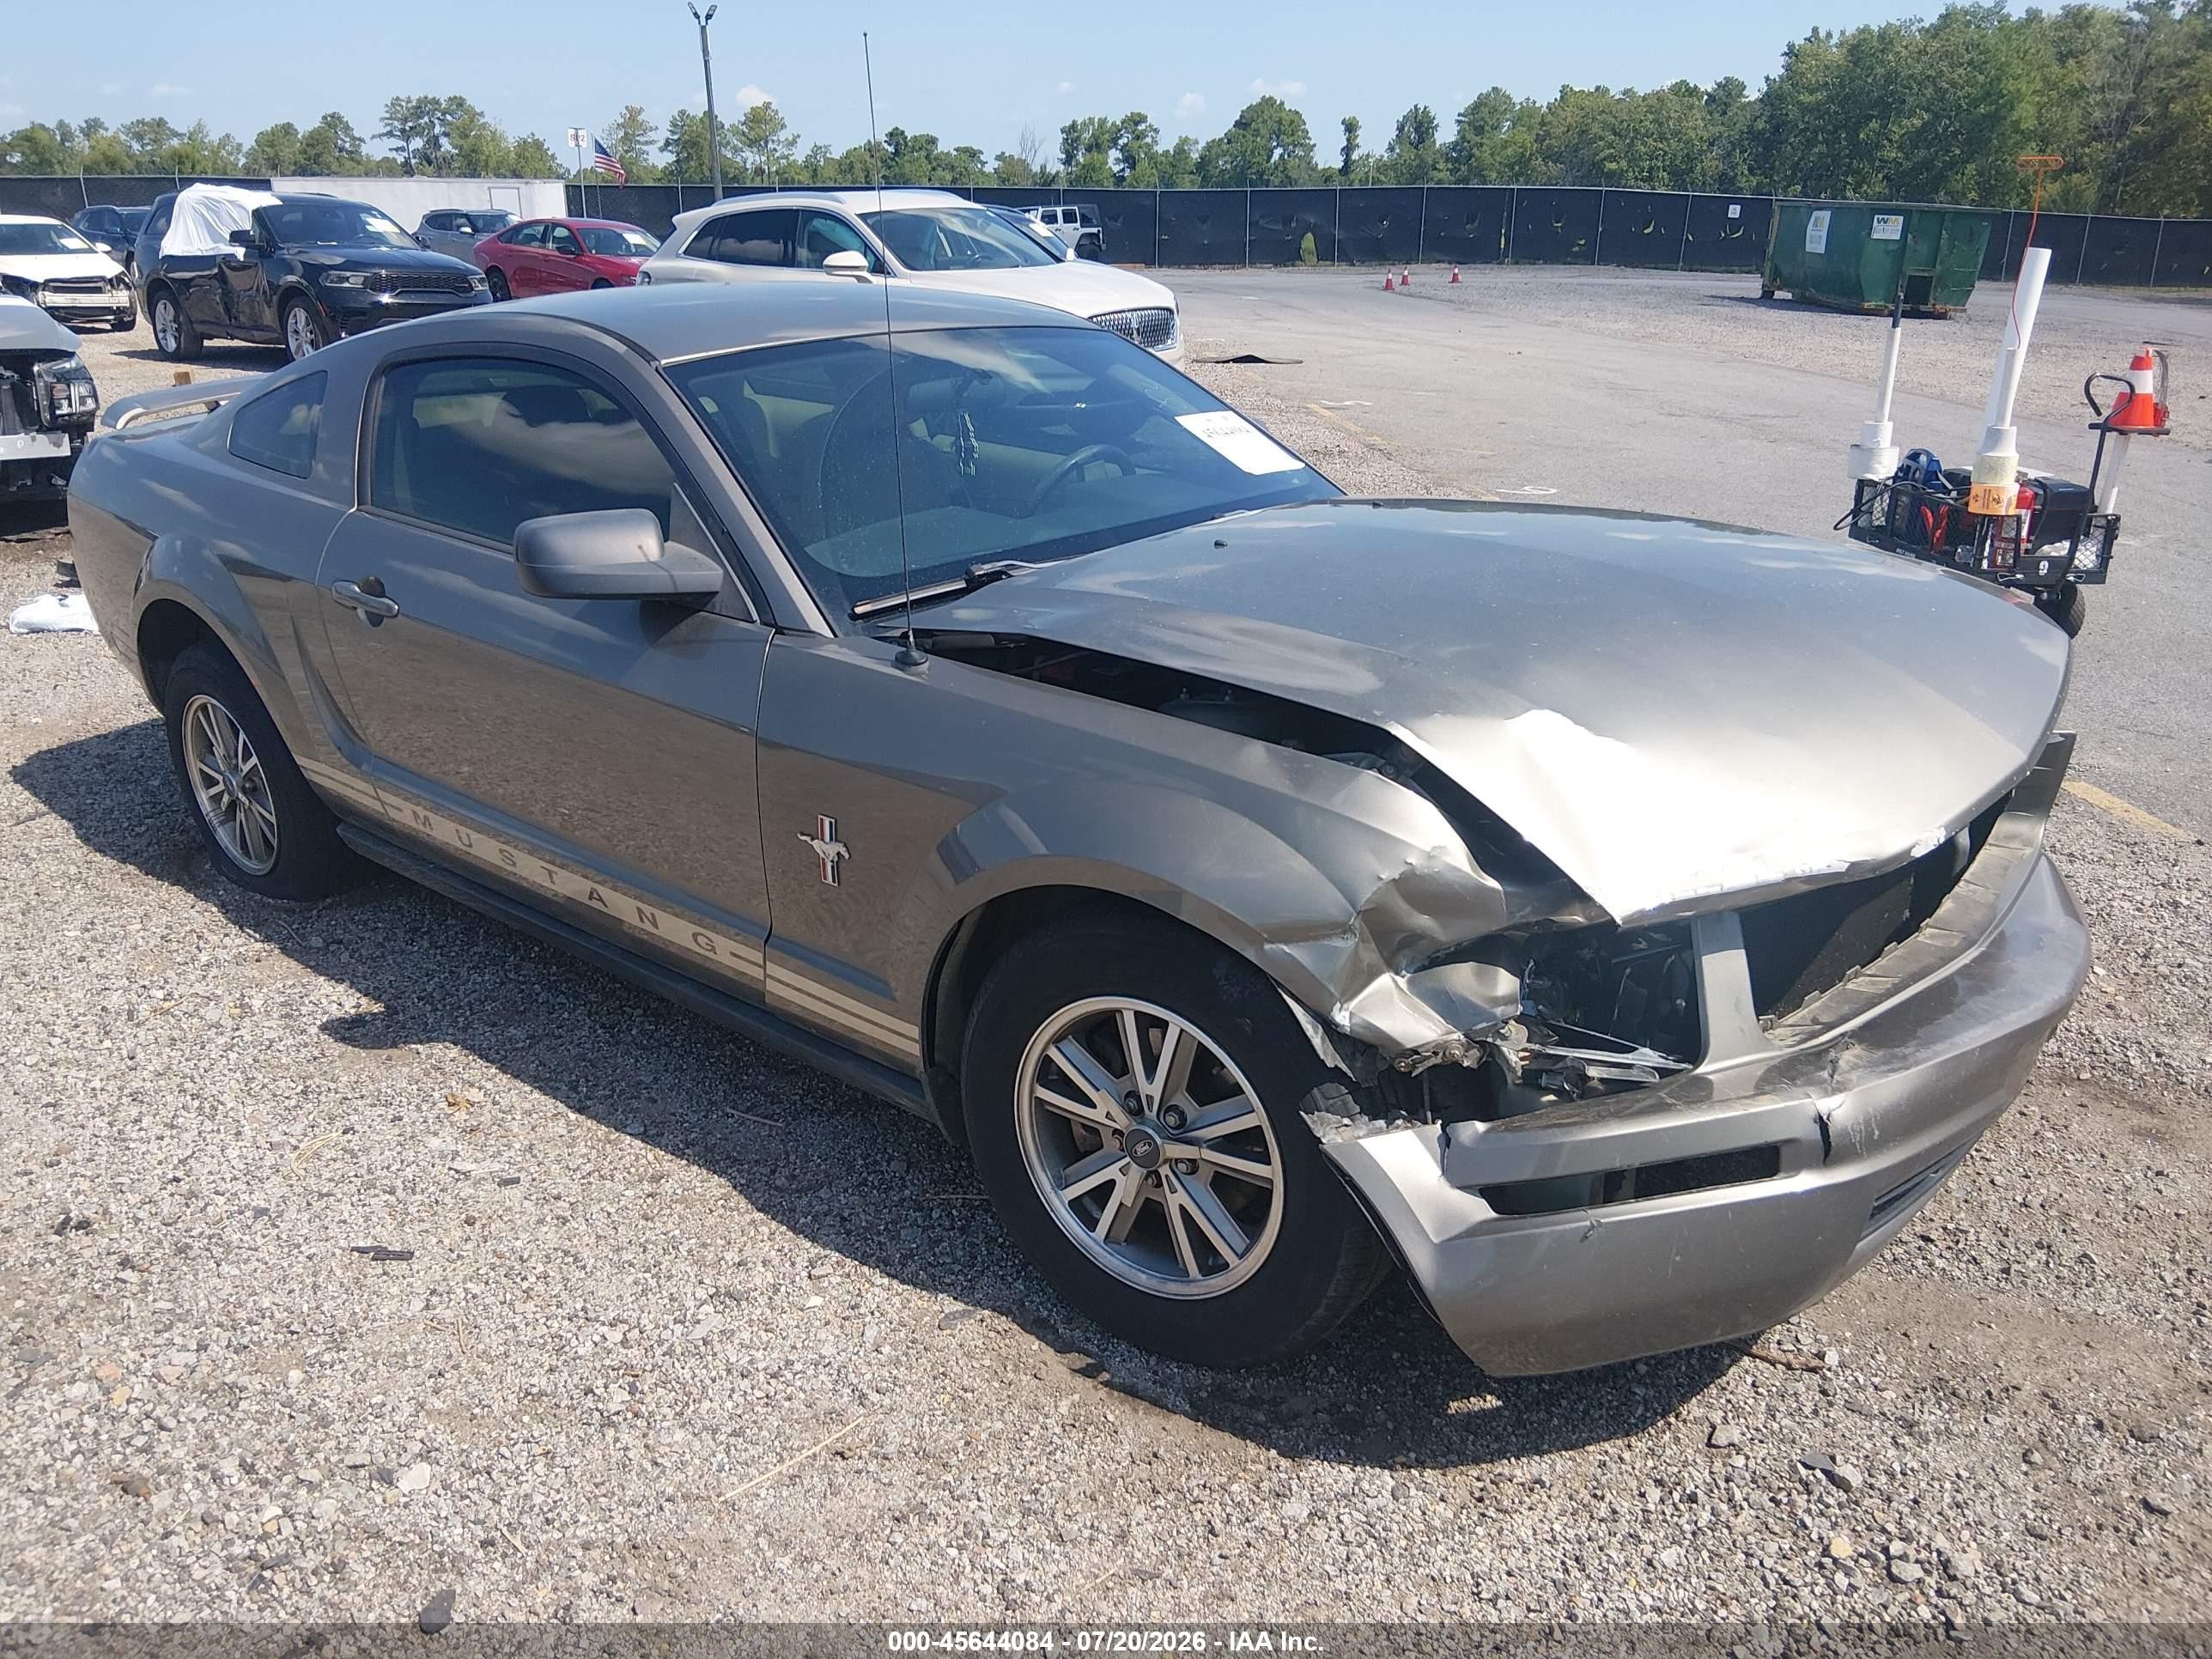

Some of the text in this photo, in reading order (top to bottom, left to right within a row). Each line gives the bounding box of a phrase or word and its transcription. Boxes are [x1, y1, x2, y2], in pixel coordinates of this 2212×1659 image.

[2039, 560, 2049, 576] 9
[410, 809, 718, 956] MUSTANG
[1134, 1141, 1151, 1156] Ford
